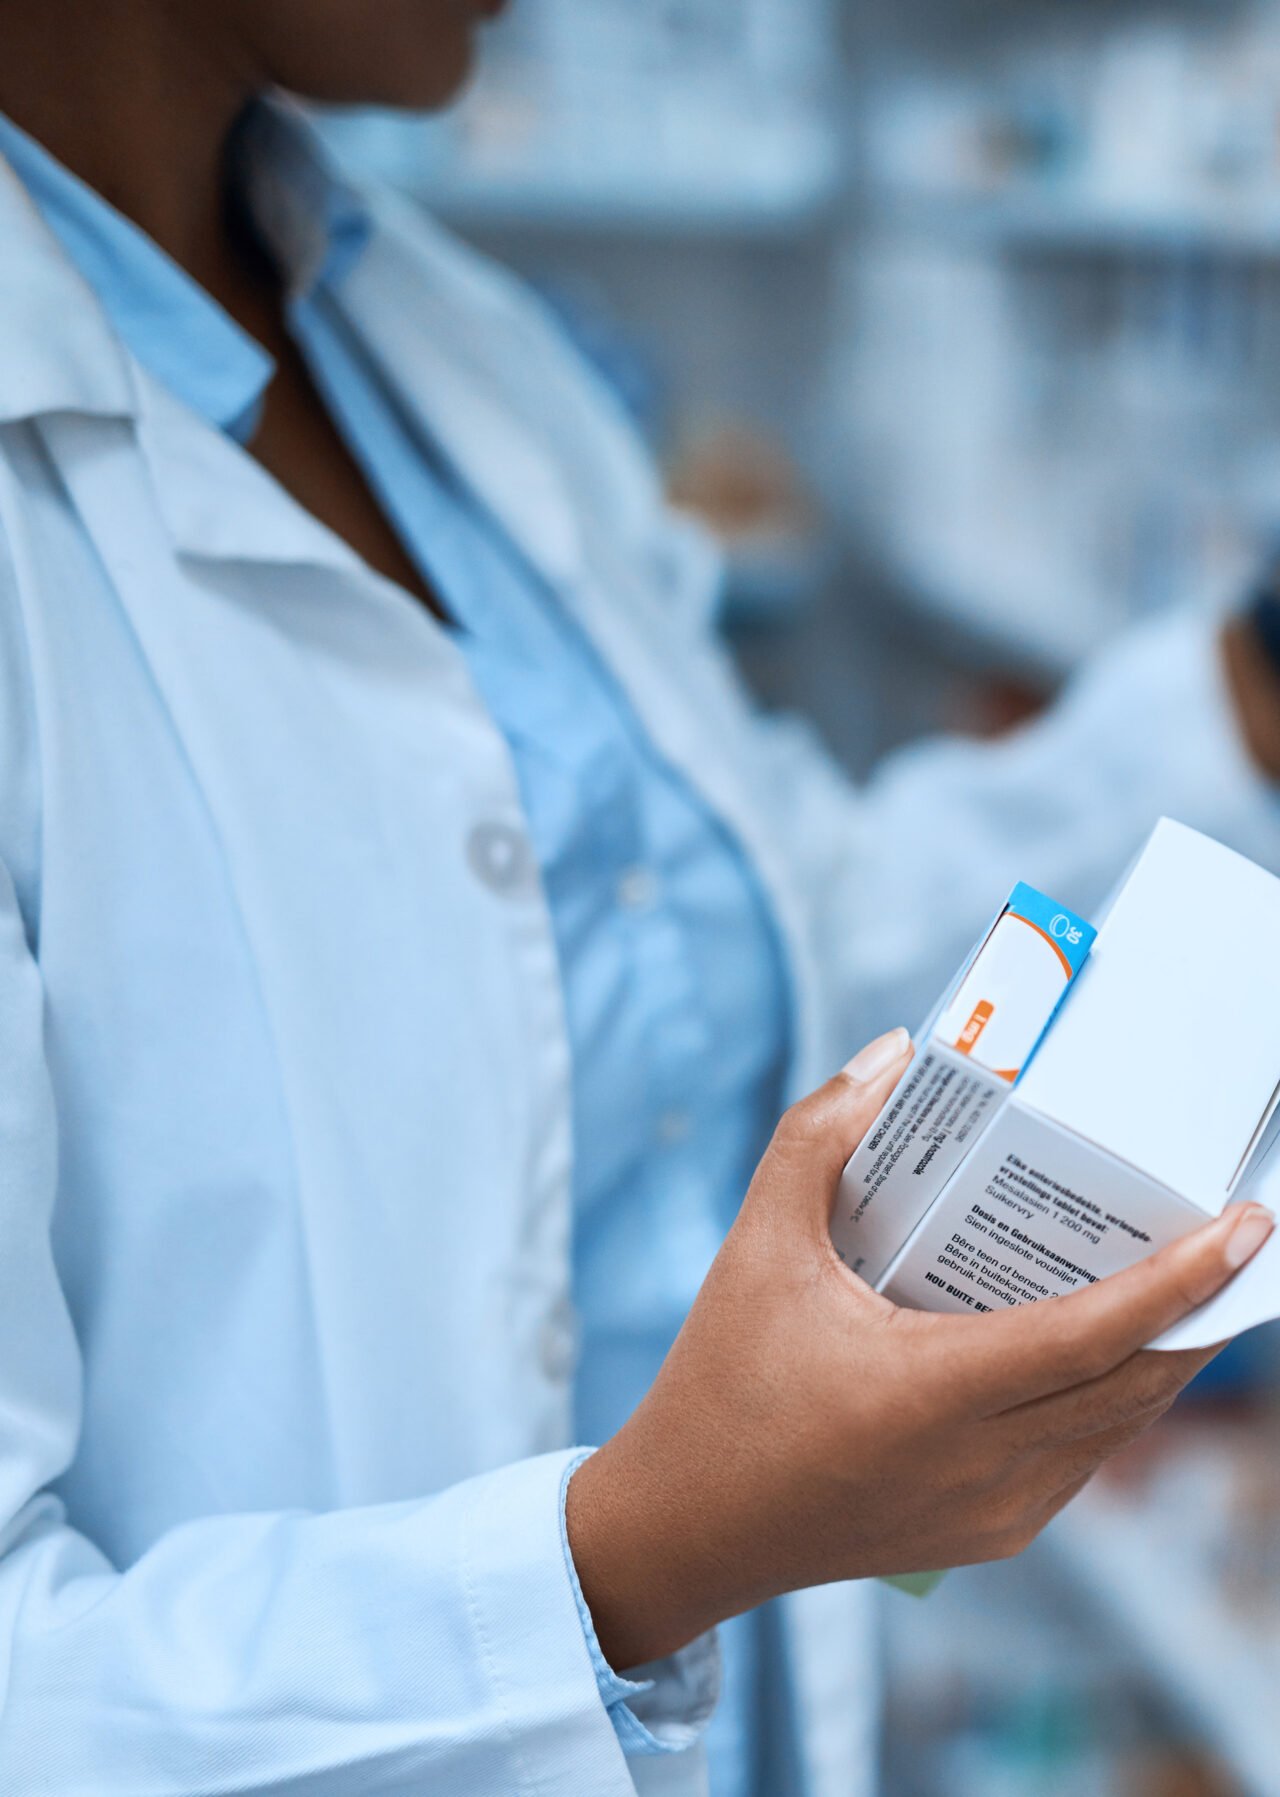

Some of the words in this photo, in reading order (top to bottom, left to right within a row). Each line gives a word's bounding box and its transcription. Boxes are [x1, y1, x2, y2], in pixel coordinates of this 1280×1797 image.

[1066, 927, 1082, 944] 30
[962, 1021, 980, 1044] mg
[882, 1121, 890, 1130] OF
[886, 1108, 899, 1123] SIGHT
[867, 1128, 886, 1150] CHILDREN
[932, 1132, 946, 1143] mg
[869, 1168, 878, 1176] for
[872, 1150, 889, 1170] required
[912, 1142, 940, 1174] Anastrozole.
[1006, 1154, 1026, 1170] Elke
[985, 1185, 1033, 1219] Suikervry
[992, 1174, 1049, 1213] Mesalasien
[1059, 1215, 1082, 1232] 200
[1082, 1229, 1100, 1244] mg
[1052, 1197, 1080, 1216] tablet
[1080, 1213, 1108, 1232] bevat:
[971, 1204, 996, 1224] Dosis
[996, 1221, 1009, 1232] en
[964, 1214, 987, 1232] Sien
[988, 1229, 1033, 1260] ingeslote
[1035, 1257, 1077, 1285] voubiljet
[944, 1243, 968, 1262] Bêre
[968, 1258, 979, 1269] in
[980, 1265, 1037, 1301] buitekarton
[951, 1233, 975, 1252] Bêre
[976, 1249, 998, 1266] teen
[999, 1264, 1012, 1273] of
[1011, 1269, 1048, 1295] benede
[924, 1271, 946, 1287] HOU
[945, 1284, 974, 1305] BUITE
[936, 1254, 975, 1280] gebruik
[976, 1276, 1016, 1305] benodig
